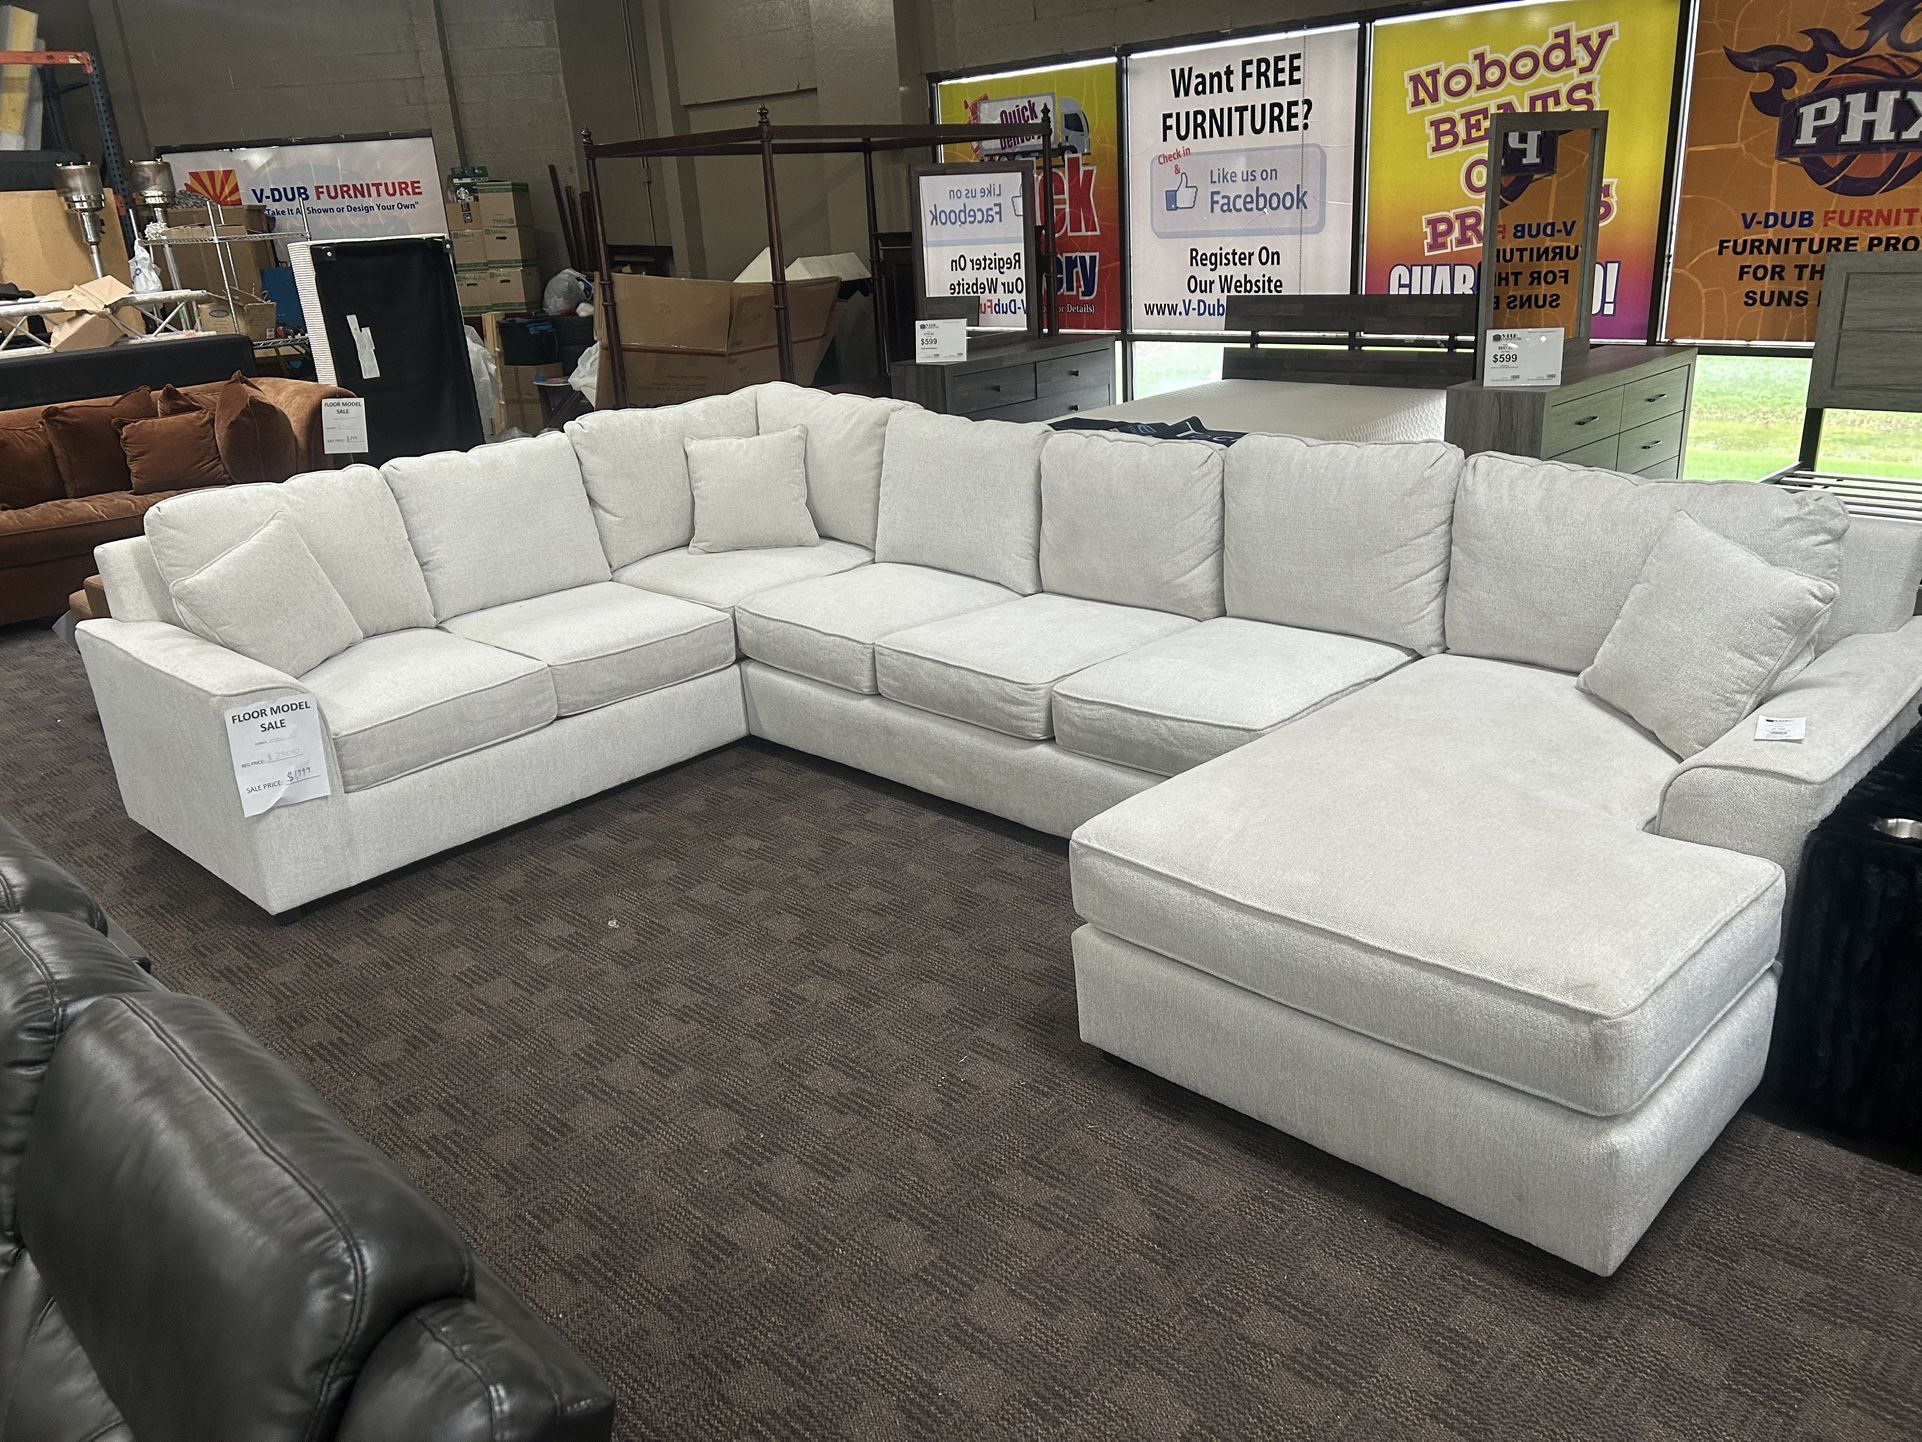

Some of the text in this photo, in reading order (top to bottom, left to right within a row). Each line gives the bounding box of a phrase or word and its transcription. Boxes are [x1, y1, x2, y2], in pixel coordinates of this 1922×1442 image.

[1170, 52, 1302, 98] Want FREE
[1407, 27, 1616, 109] Nobody
[1000, 100, 1038, 123] Quick
[1162, 98, 1313, 142] FURNITURE?
[1157, 146, 1191, 165] Check in
[1174, 163, 1181, 175] &
[1209, 168, 1278, 184] Like us on
[251, 180, 423, 204] V-DUB FURNITURE
[1210, 184, 1309, 213] Facebook
[287, 207, 294, 215] It
[307, 206, 335, 215] Shown
[336, 206, 345, 214] or
[346, 203, 375, 215] Design
[375, 202, 396, 212] Your
[396, 201, 419, 210] Own"
[1741, 208, 1922, 230] V-DUB FURNIT
[1717, 235, 1922, 257] FURNITURE PRO
[1189, 245, 1281, 272] Register On
[1738, 264, 1825, 282] FOR TH
[1187, 274, 1284, 294] Our Website
[1743, 289, 1810, 307] SUNS
[1066, 303, 1095, 314] Details)
[920, 338, 938, 346] $599
[1492, 353, 1518, 363] $599
[231, 701, 311, 724] FLOOR MODEL
[260, 718, 287, 733] SALE
[246, 784, 262, 794] SALE
